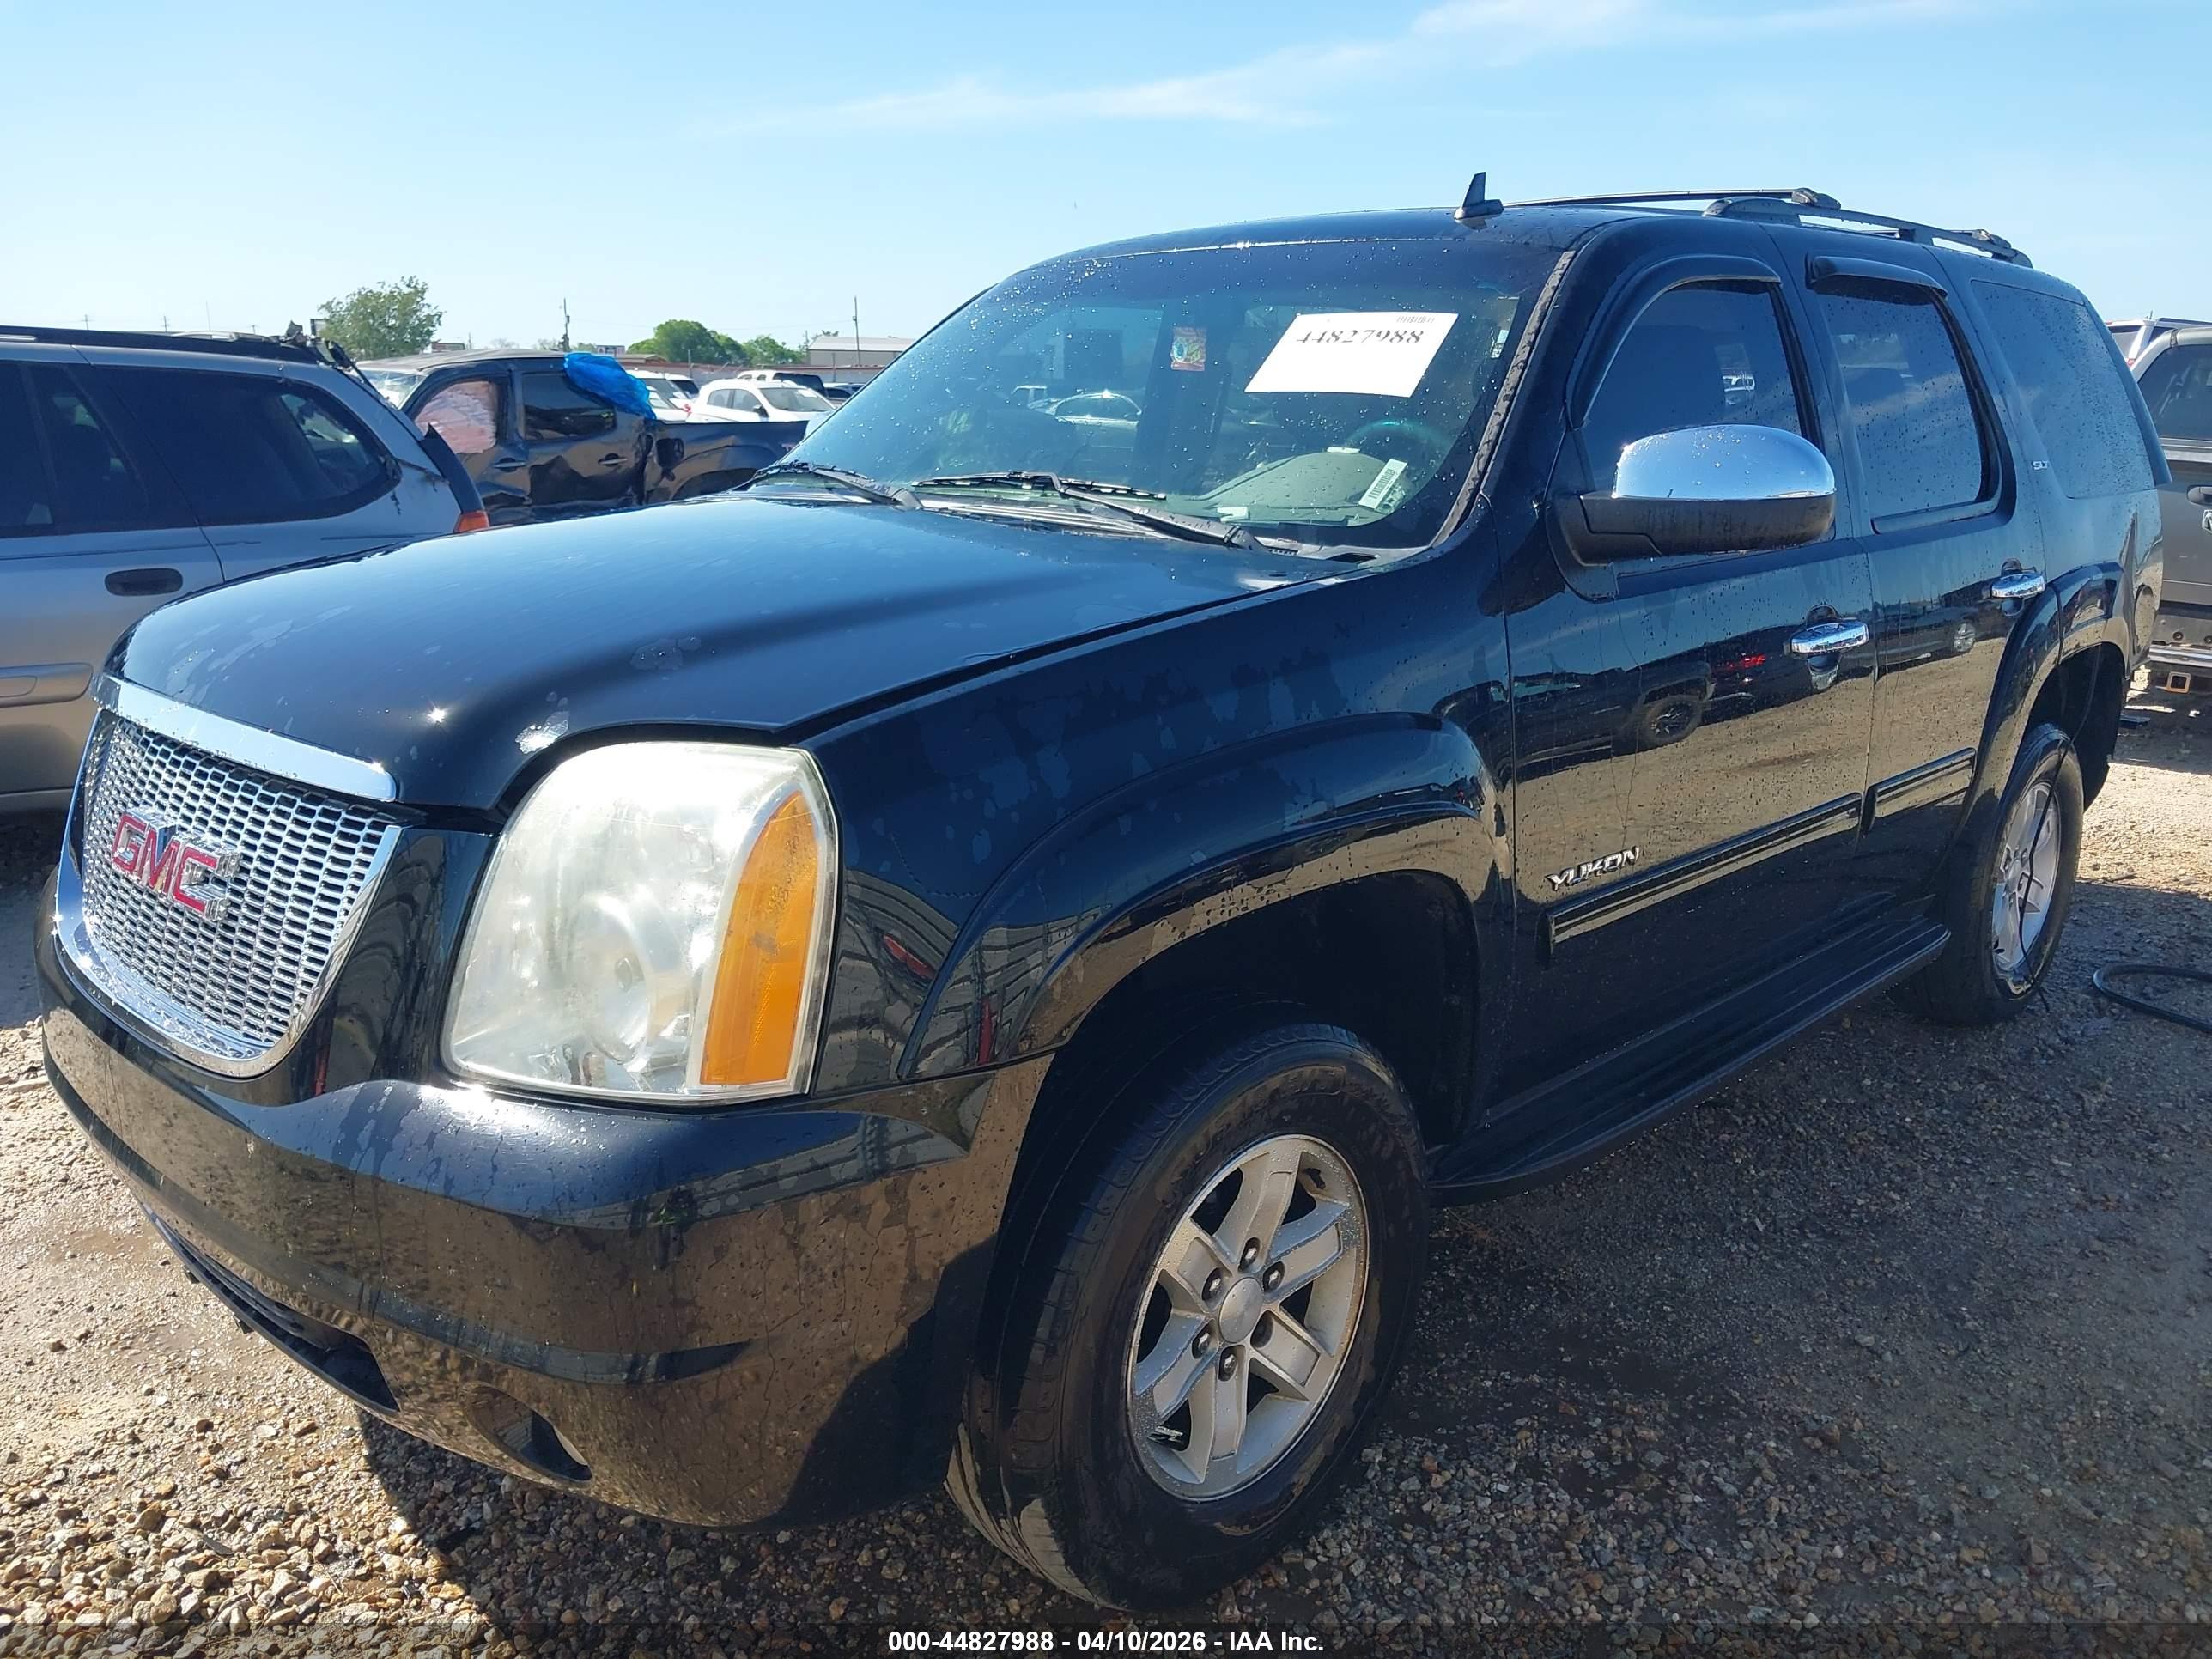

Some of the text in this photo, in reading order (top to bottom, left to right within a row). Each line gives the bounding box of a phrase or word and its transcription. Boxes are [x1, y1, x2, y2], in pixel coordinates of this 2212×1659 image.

[1297, 329, 1425, 344] 44827988
[111, 811, 220, 916] GMC
[1545, 846, 1640, 891] YUKON
